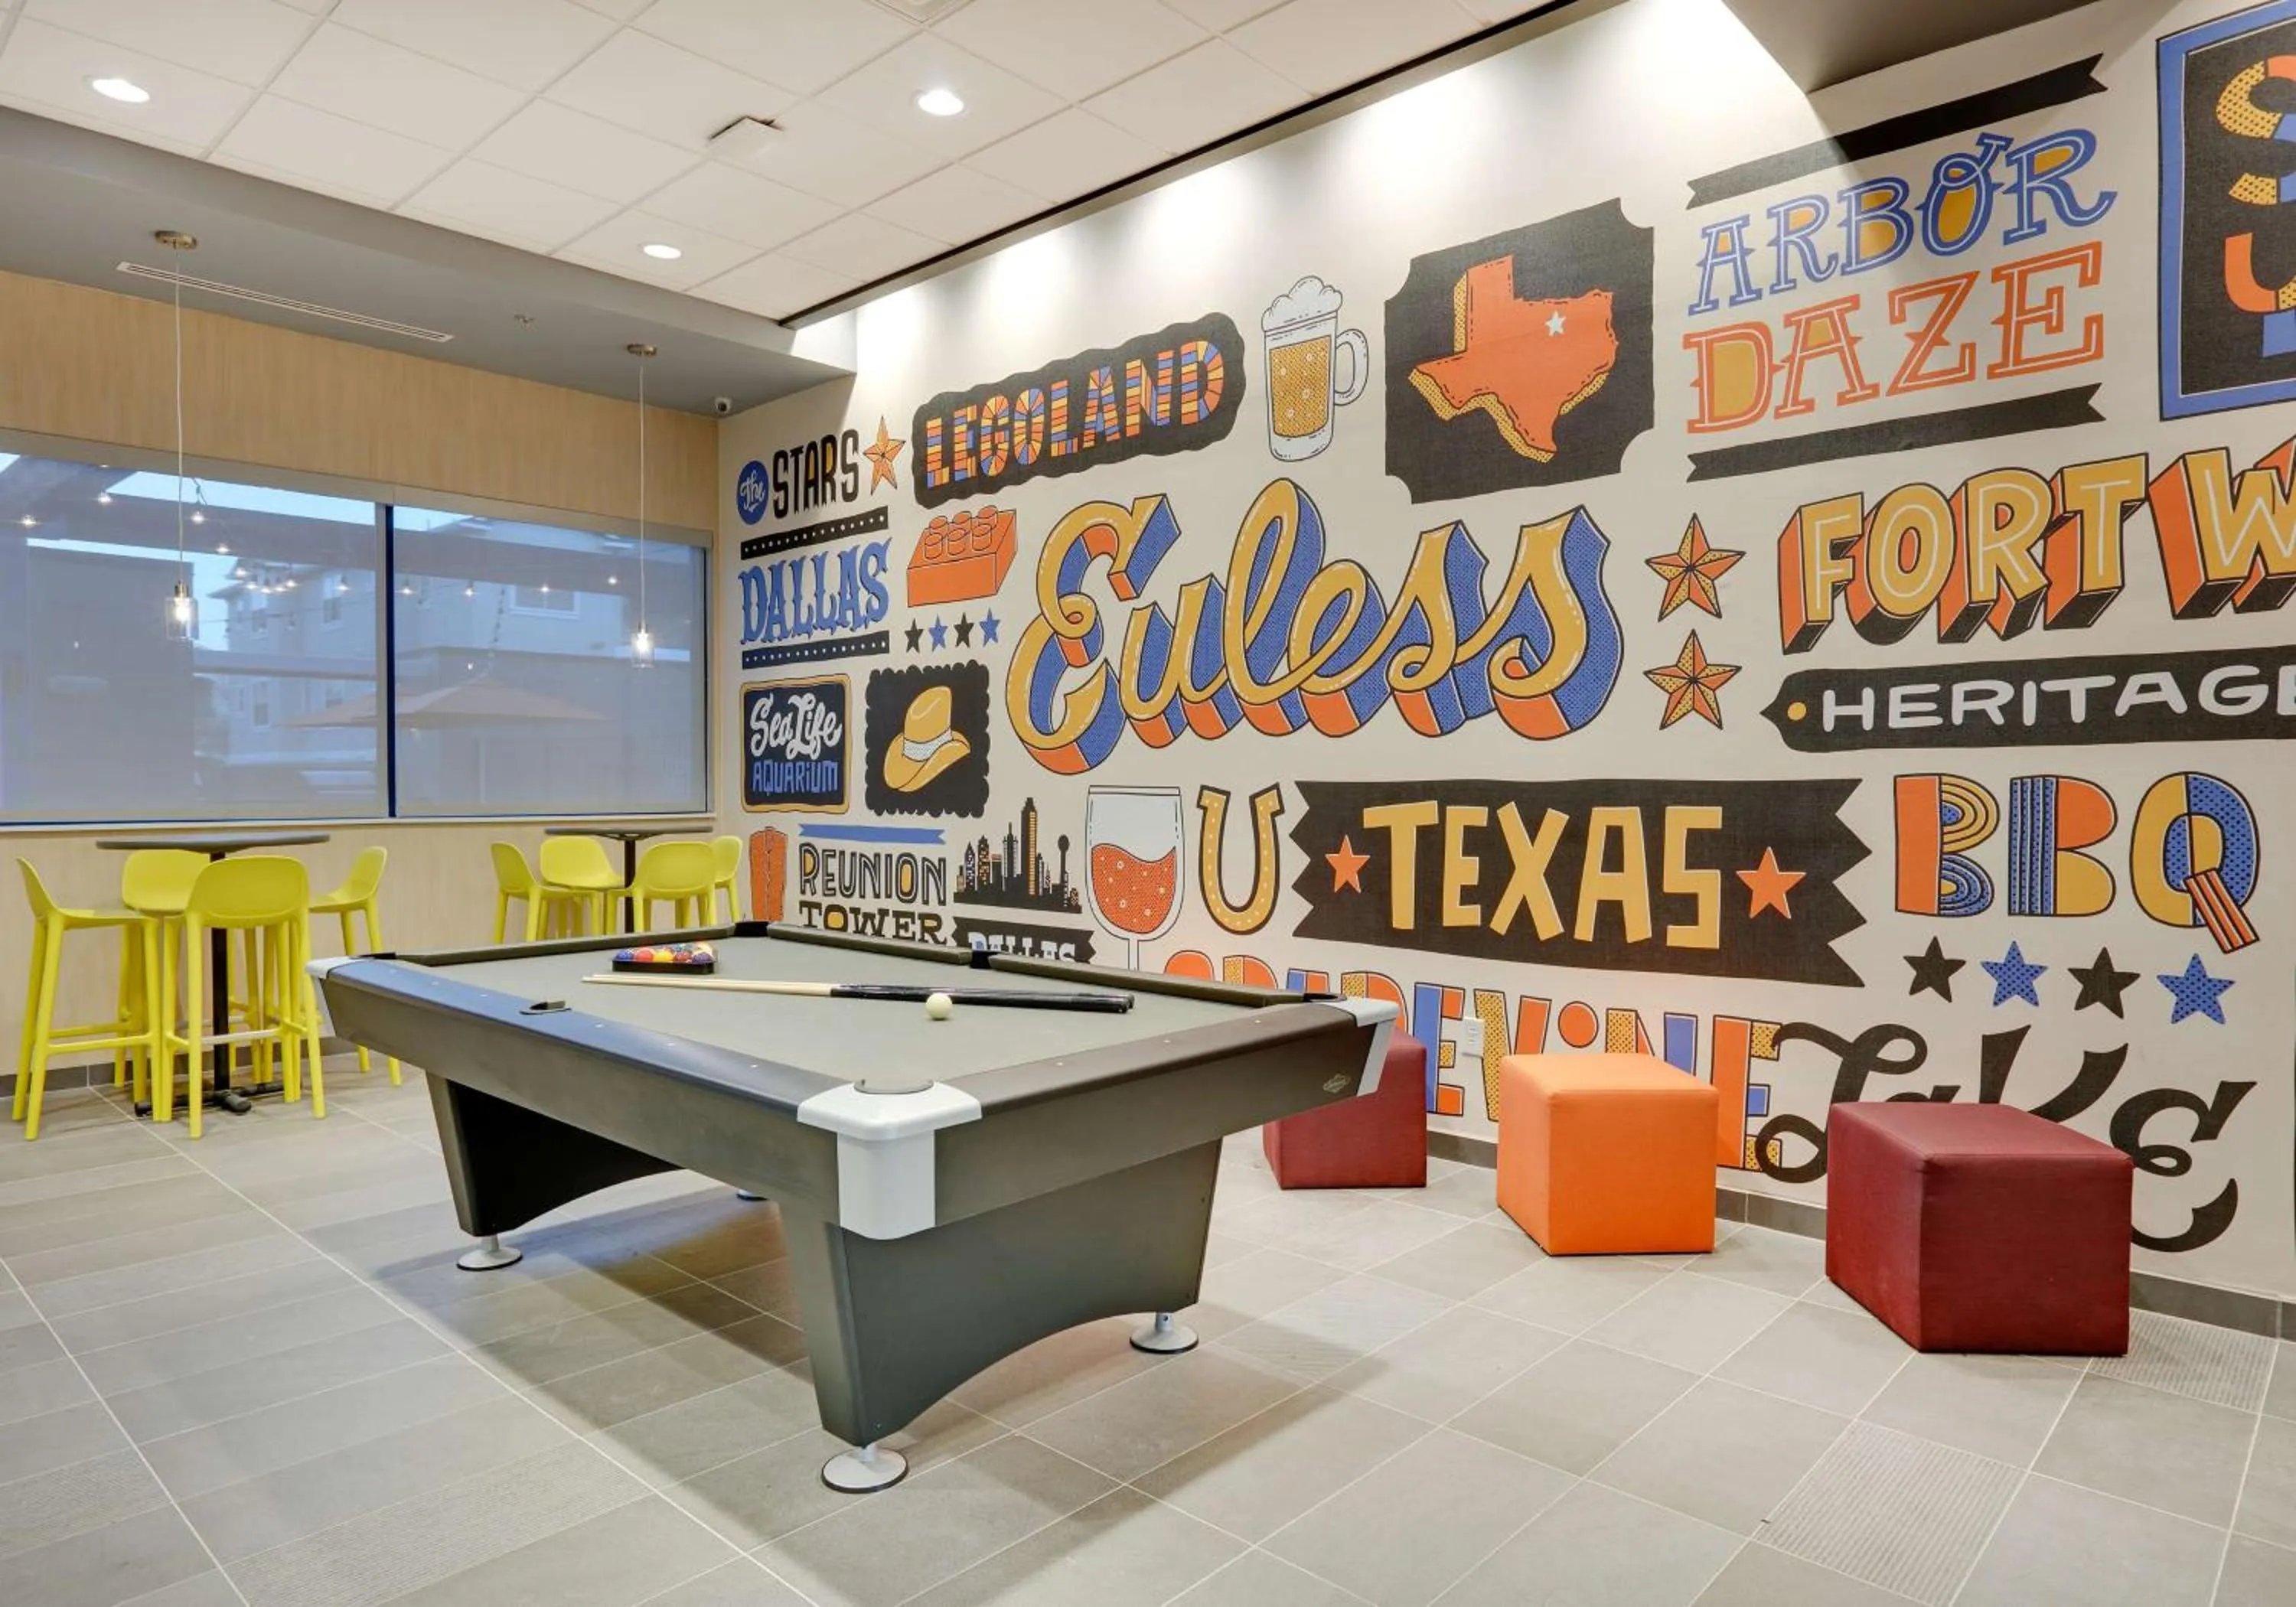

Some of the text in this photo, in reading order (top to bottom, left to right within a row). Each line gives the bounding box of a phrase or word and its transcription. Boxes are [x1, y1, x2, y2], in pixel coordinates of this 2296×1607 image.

[1688, 129, 2118, 316] ARBOR
[1683, 242, 2105, 434] DAZE
[772, 429, 859, 519] STARS
[926, 341, 1225, 487] LEGOLAND
[738, 537, 892, 644] DALLAS
[1006, 478, 1624, 775] Euless
[1778, 453, 2149, 655] FORT
[749, 692, 843, 761] Sea Life
[798, 843, 947, 906] REUNION
[798, 900, 947, 945] TOWER
[1362, 800, 1724, 950] TEXAS
[1893, 771, 2260, 954] BBQ
